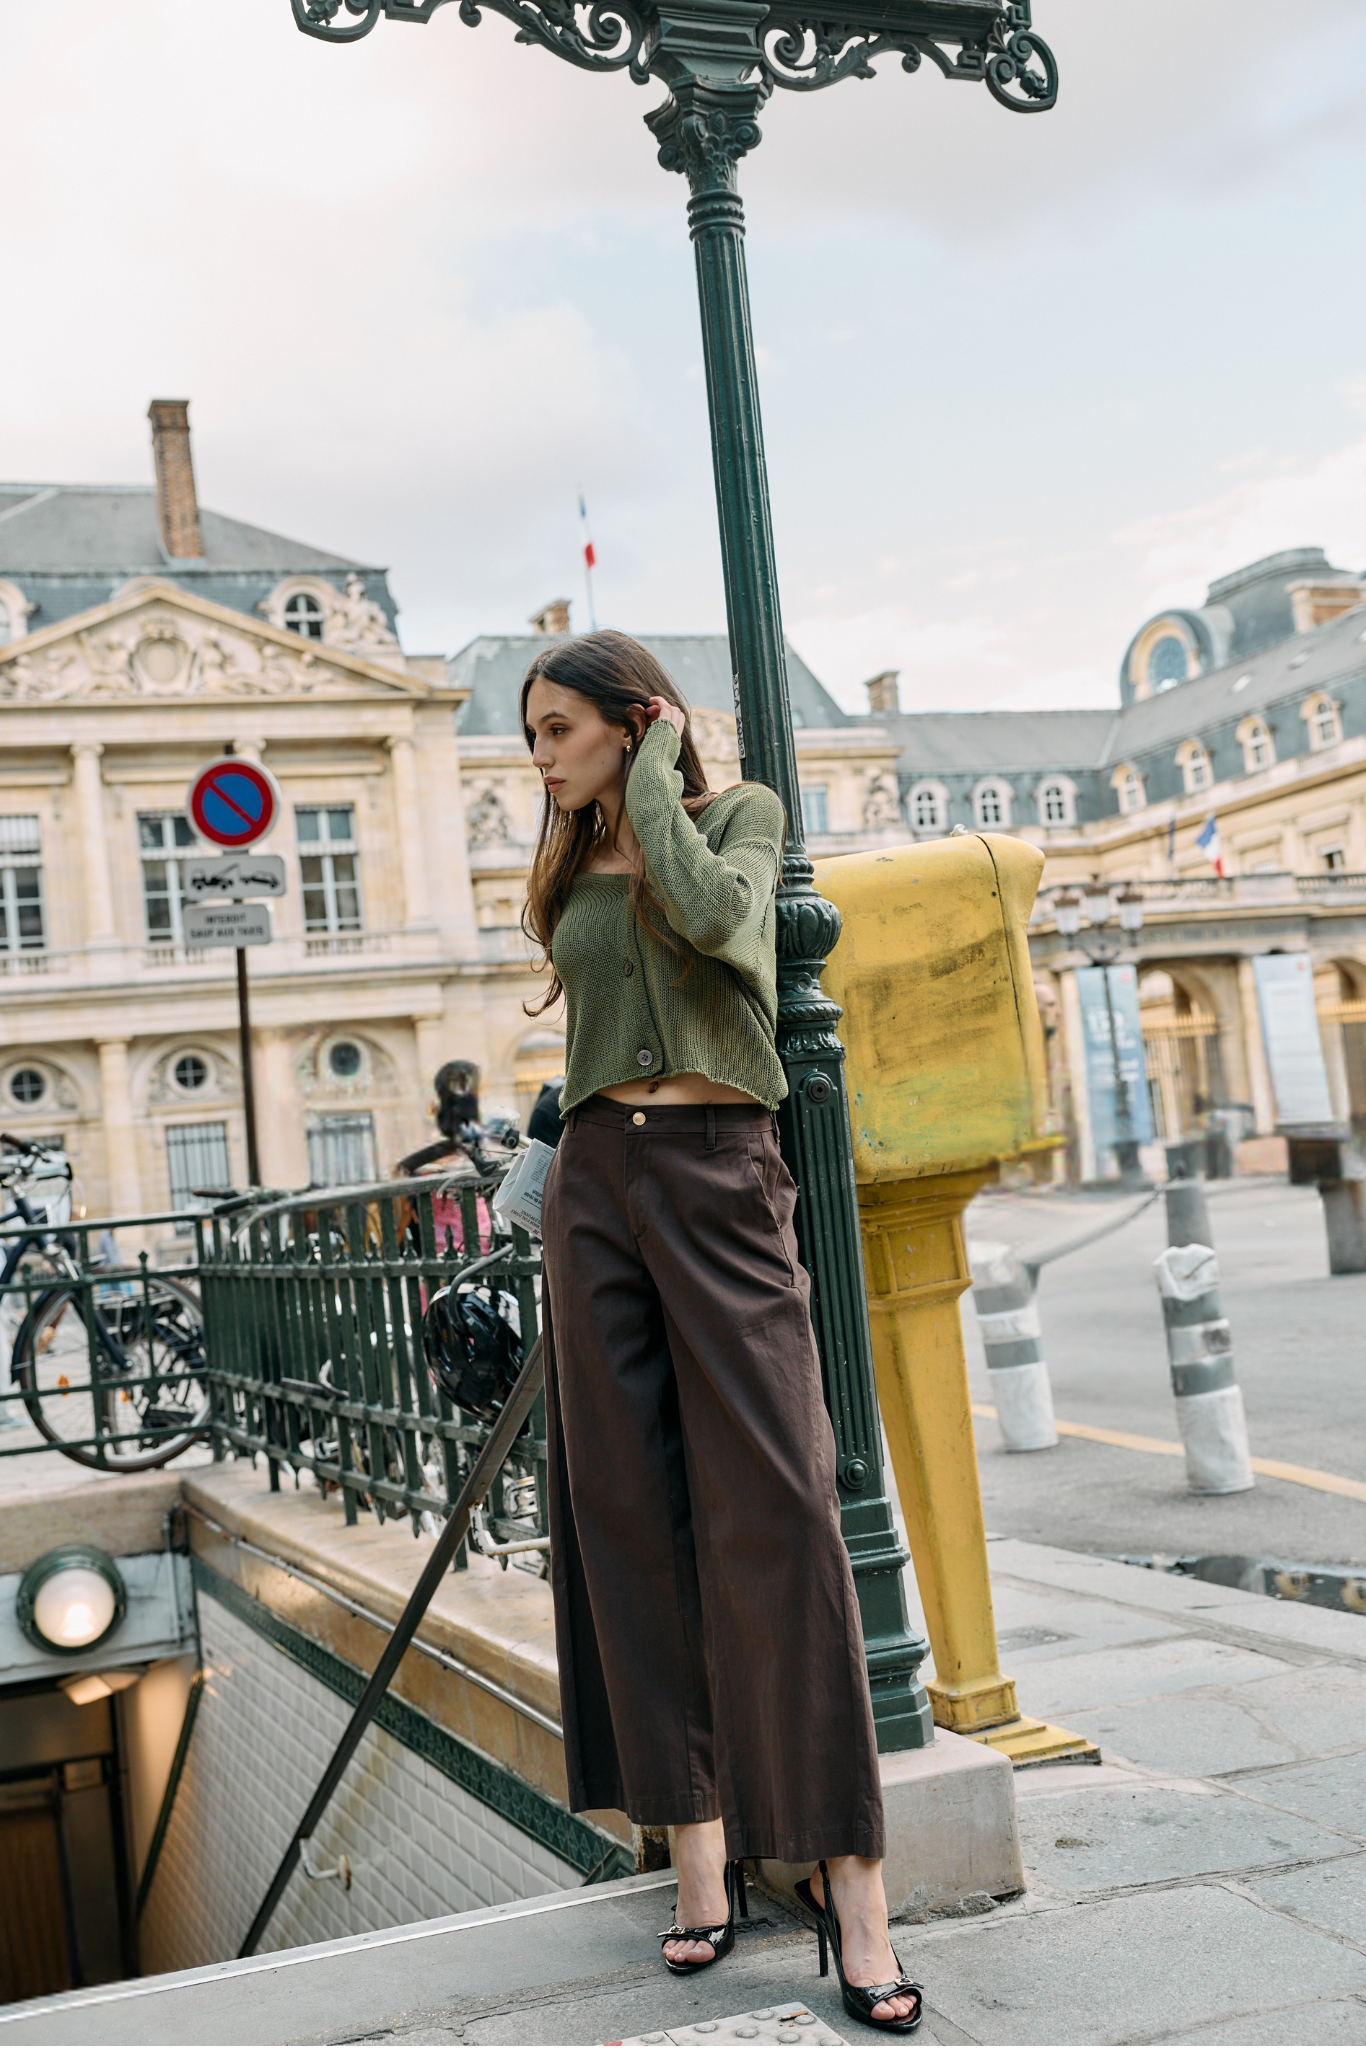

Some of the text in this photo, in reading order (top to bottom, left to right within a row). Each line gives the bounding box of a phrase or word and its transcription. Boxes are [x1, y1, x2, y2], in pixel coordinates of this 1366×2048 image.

[204, 913, 246, 924] INTERDIT
[190, 929, 213, 939] SAUF
[217, 927, 235, 937] AUX
